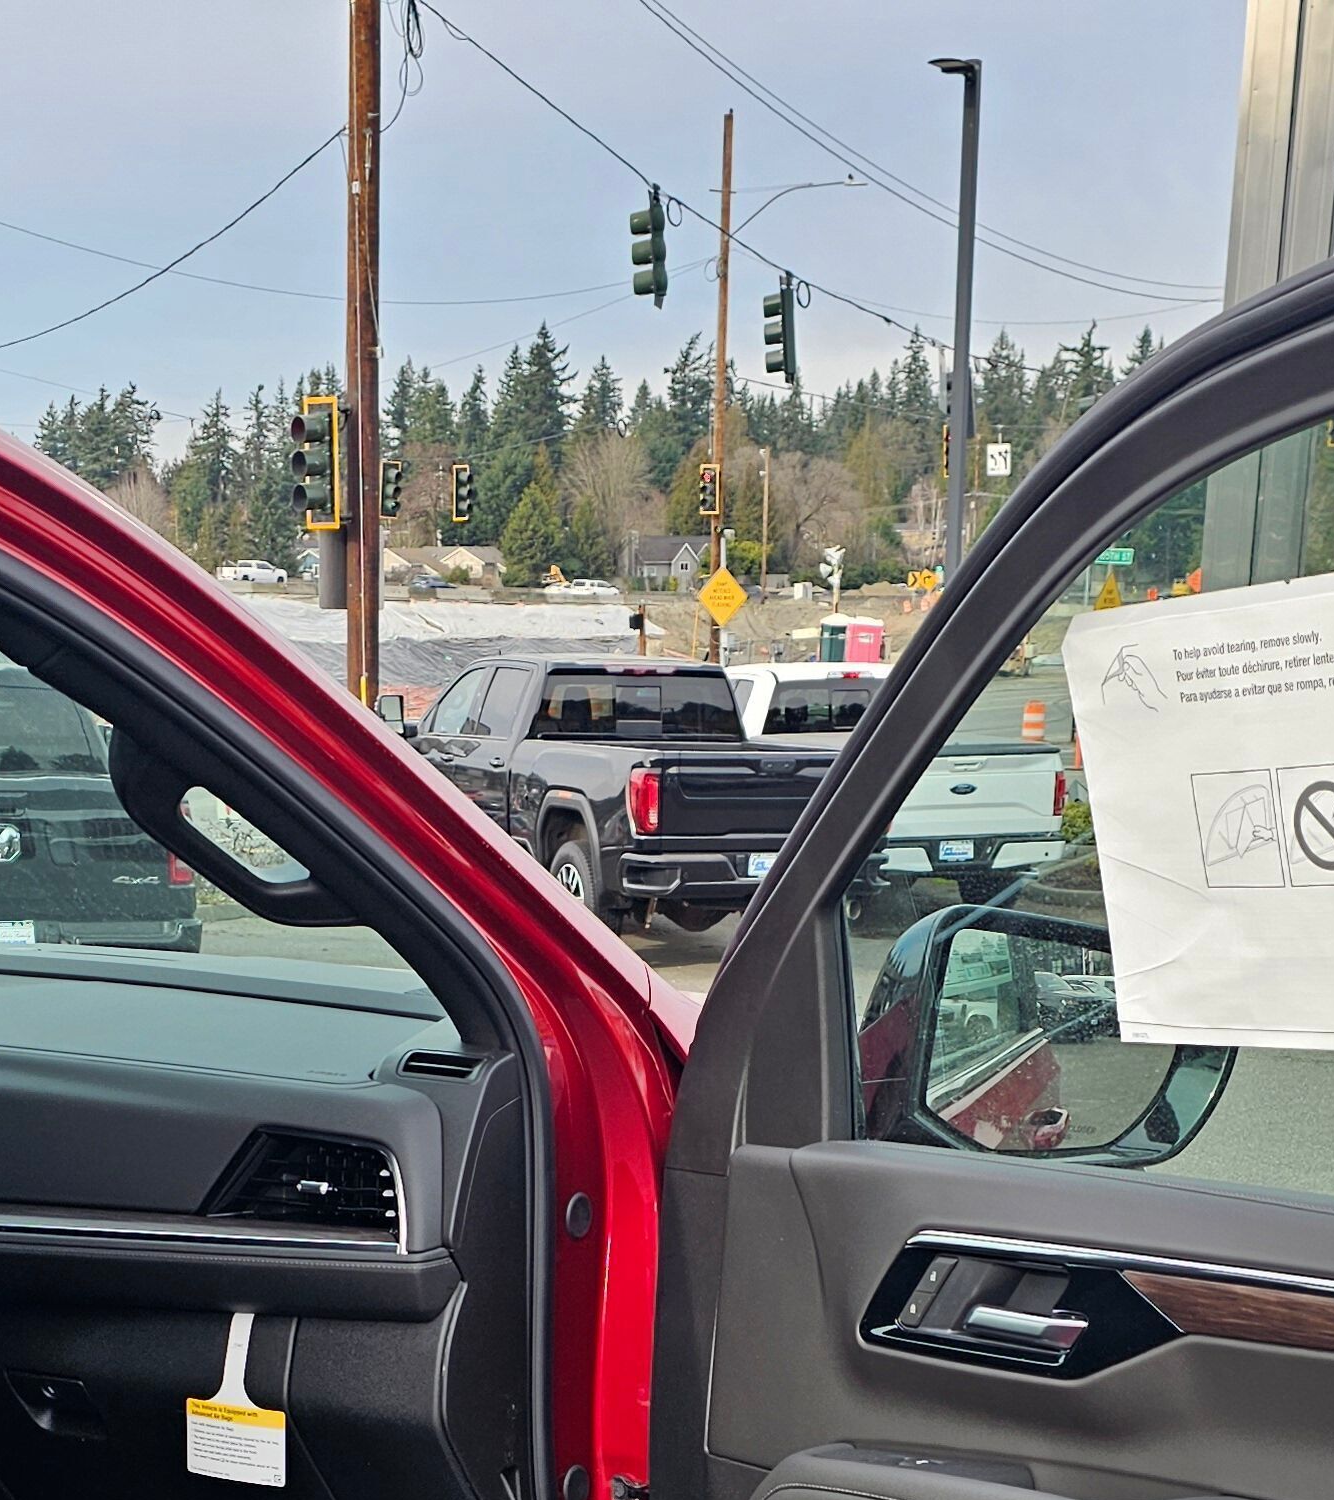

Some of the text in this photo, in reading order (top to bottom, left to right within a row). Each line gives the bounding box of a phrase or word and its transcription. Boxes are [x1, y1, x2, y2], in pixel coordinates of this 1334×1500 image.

[1172, 630, 1322, 663] To help avoid tearing, remove slowly.
[1176, 669, 1194, 682] Pour
[1218, 662, 1240, 677] toute
[1242, 658, 1283, 674] déchirure,
[1284, 655, 1311, 670] retirer
[1180, 691, 1198, 703] Para
[1199, 688, 1233, 704] ayudarse
[1234, 688, 1240, 698] a
[1242, 683, 1265, 697] evitar
[1267, 681, 1283, 696] que
[1284, 681, 1294, 692] se
[1296, 676, 1327, 691] rompa,
